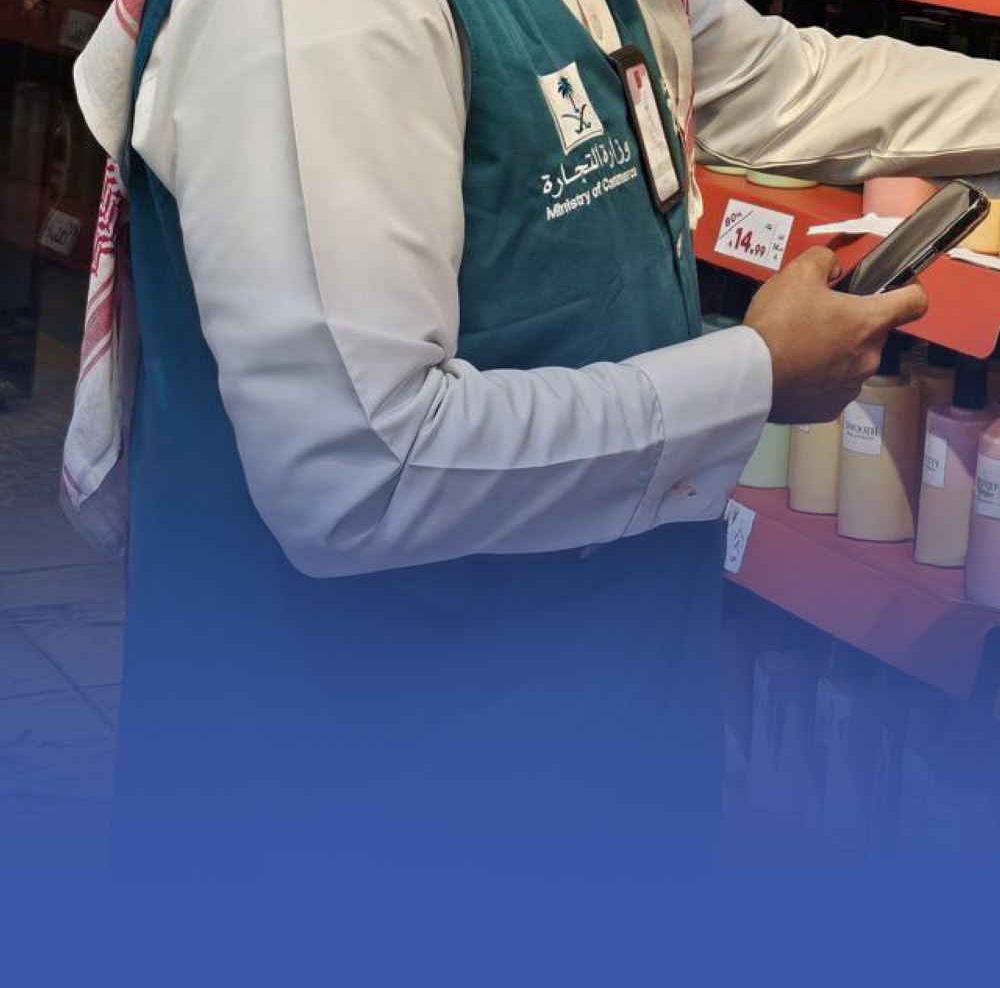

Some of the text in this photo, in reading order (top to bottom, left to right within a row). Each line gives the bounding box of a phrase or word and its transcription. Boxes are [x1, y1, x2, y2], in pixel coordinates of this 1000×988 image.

[601, 136, 631, 168] وزارة
[541, 143, 603, 199] التجارة
[546, 192, 592, 221] Ministry
[592, 180, 603, 198] of
[734, 227, 766, 258] 14.99
